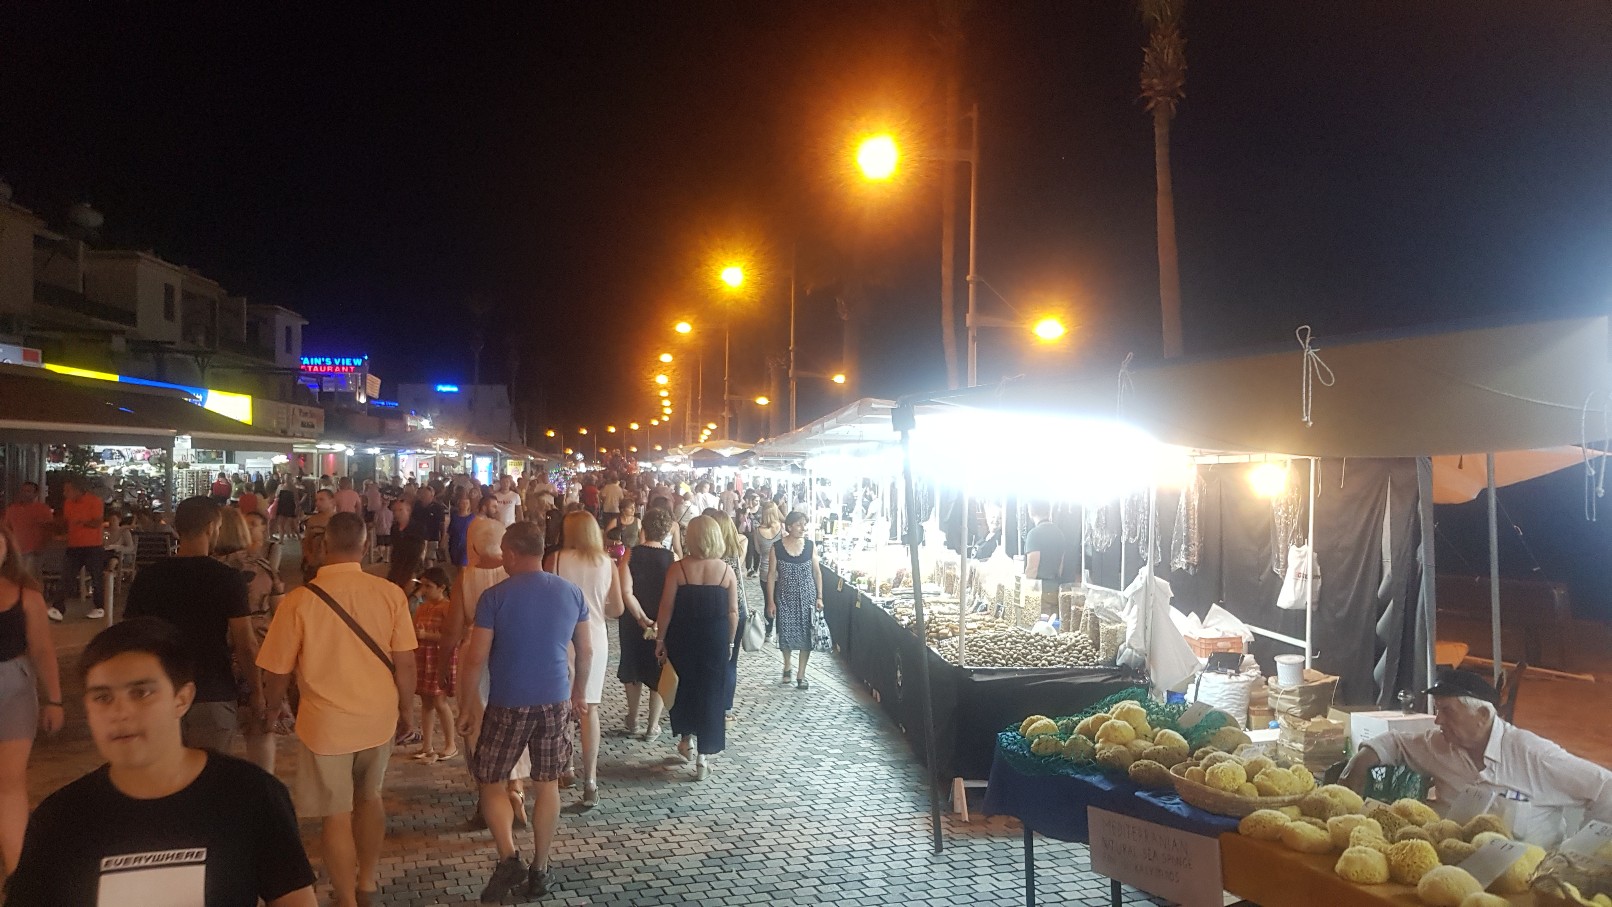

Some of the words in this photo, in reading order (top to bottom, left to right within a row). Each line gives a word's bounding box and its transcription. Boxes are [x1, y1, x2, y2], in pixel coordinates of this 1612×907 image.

[300, 357, 333, 366] AIN'S
[334, 358, 363, 367] VIEW
[103, 850, 206, 868] EVERYWHERE
